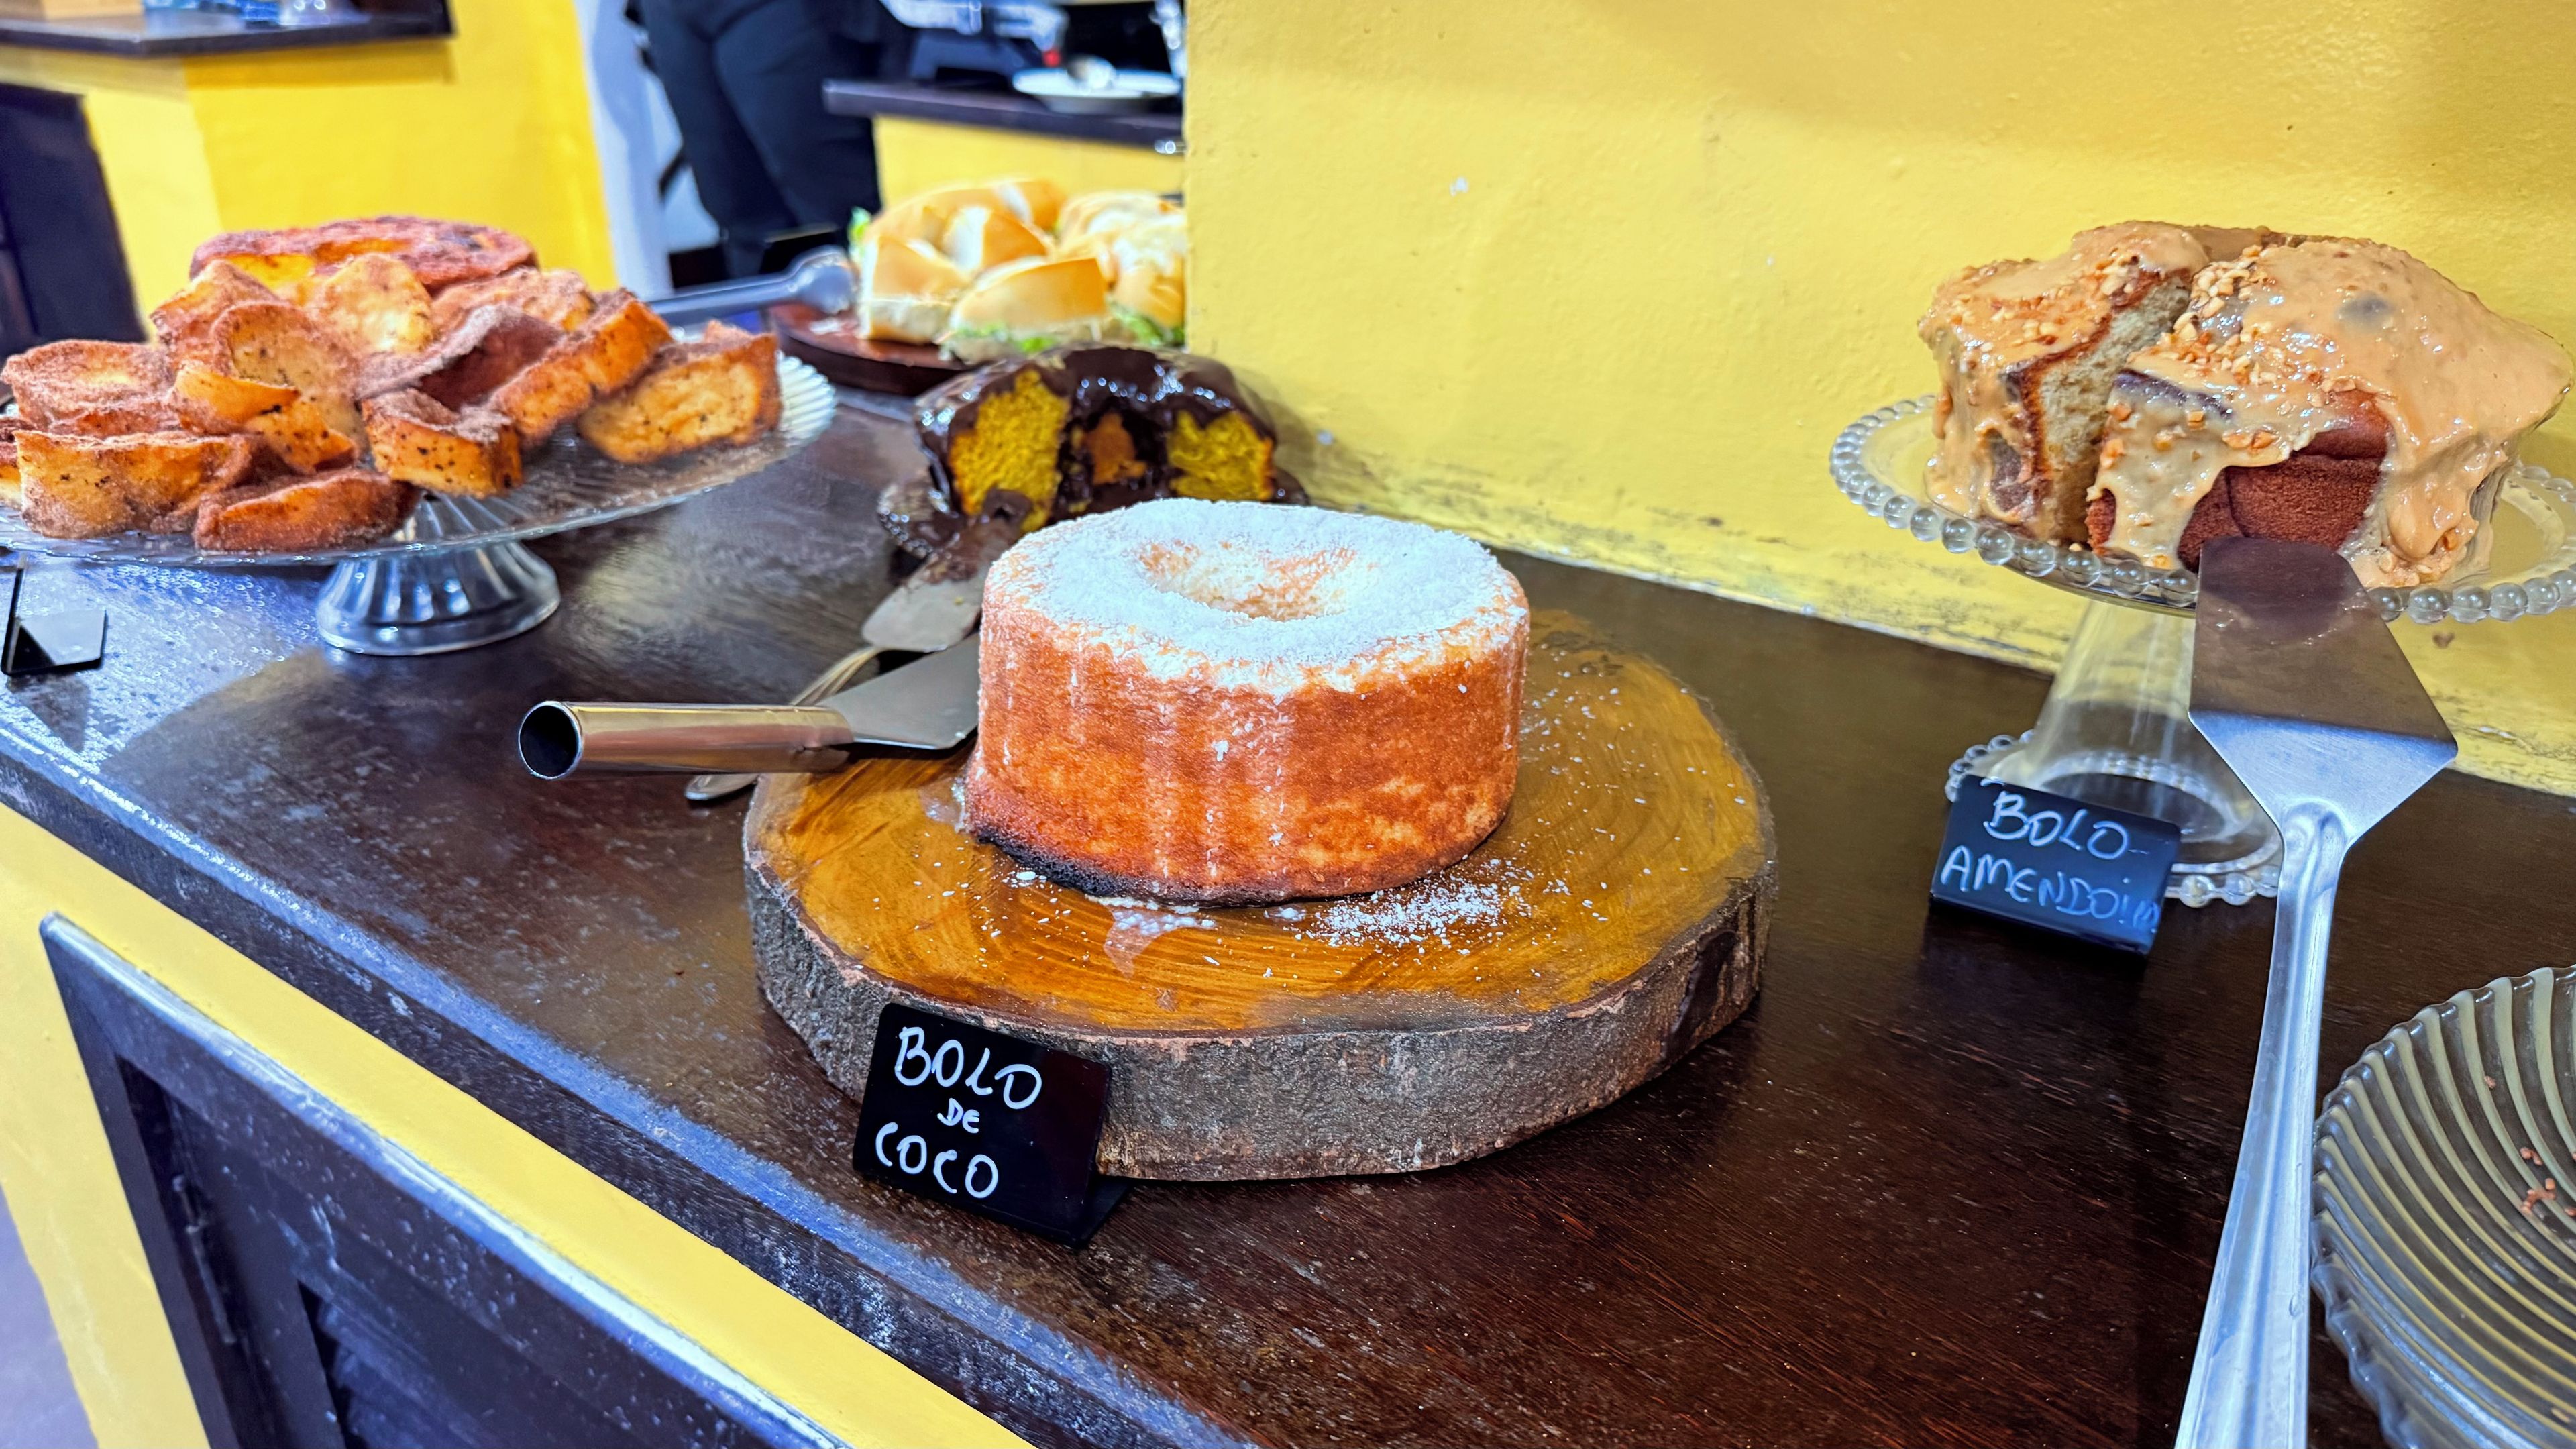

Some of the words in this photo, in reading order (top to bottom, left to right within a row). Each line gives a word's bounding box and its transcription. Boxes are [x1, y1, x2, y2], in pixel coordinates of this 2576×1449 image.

[1983, 790, 2130, 860] BOLO
[894, 1026, 1042, 1110] BOLO
[936, 1097, 980, 1134] DE
[875, 1122, 999, 1199] COCO
